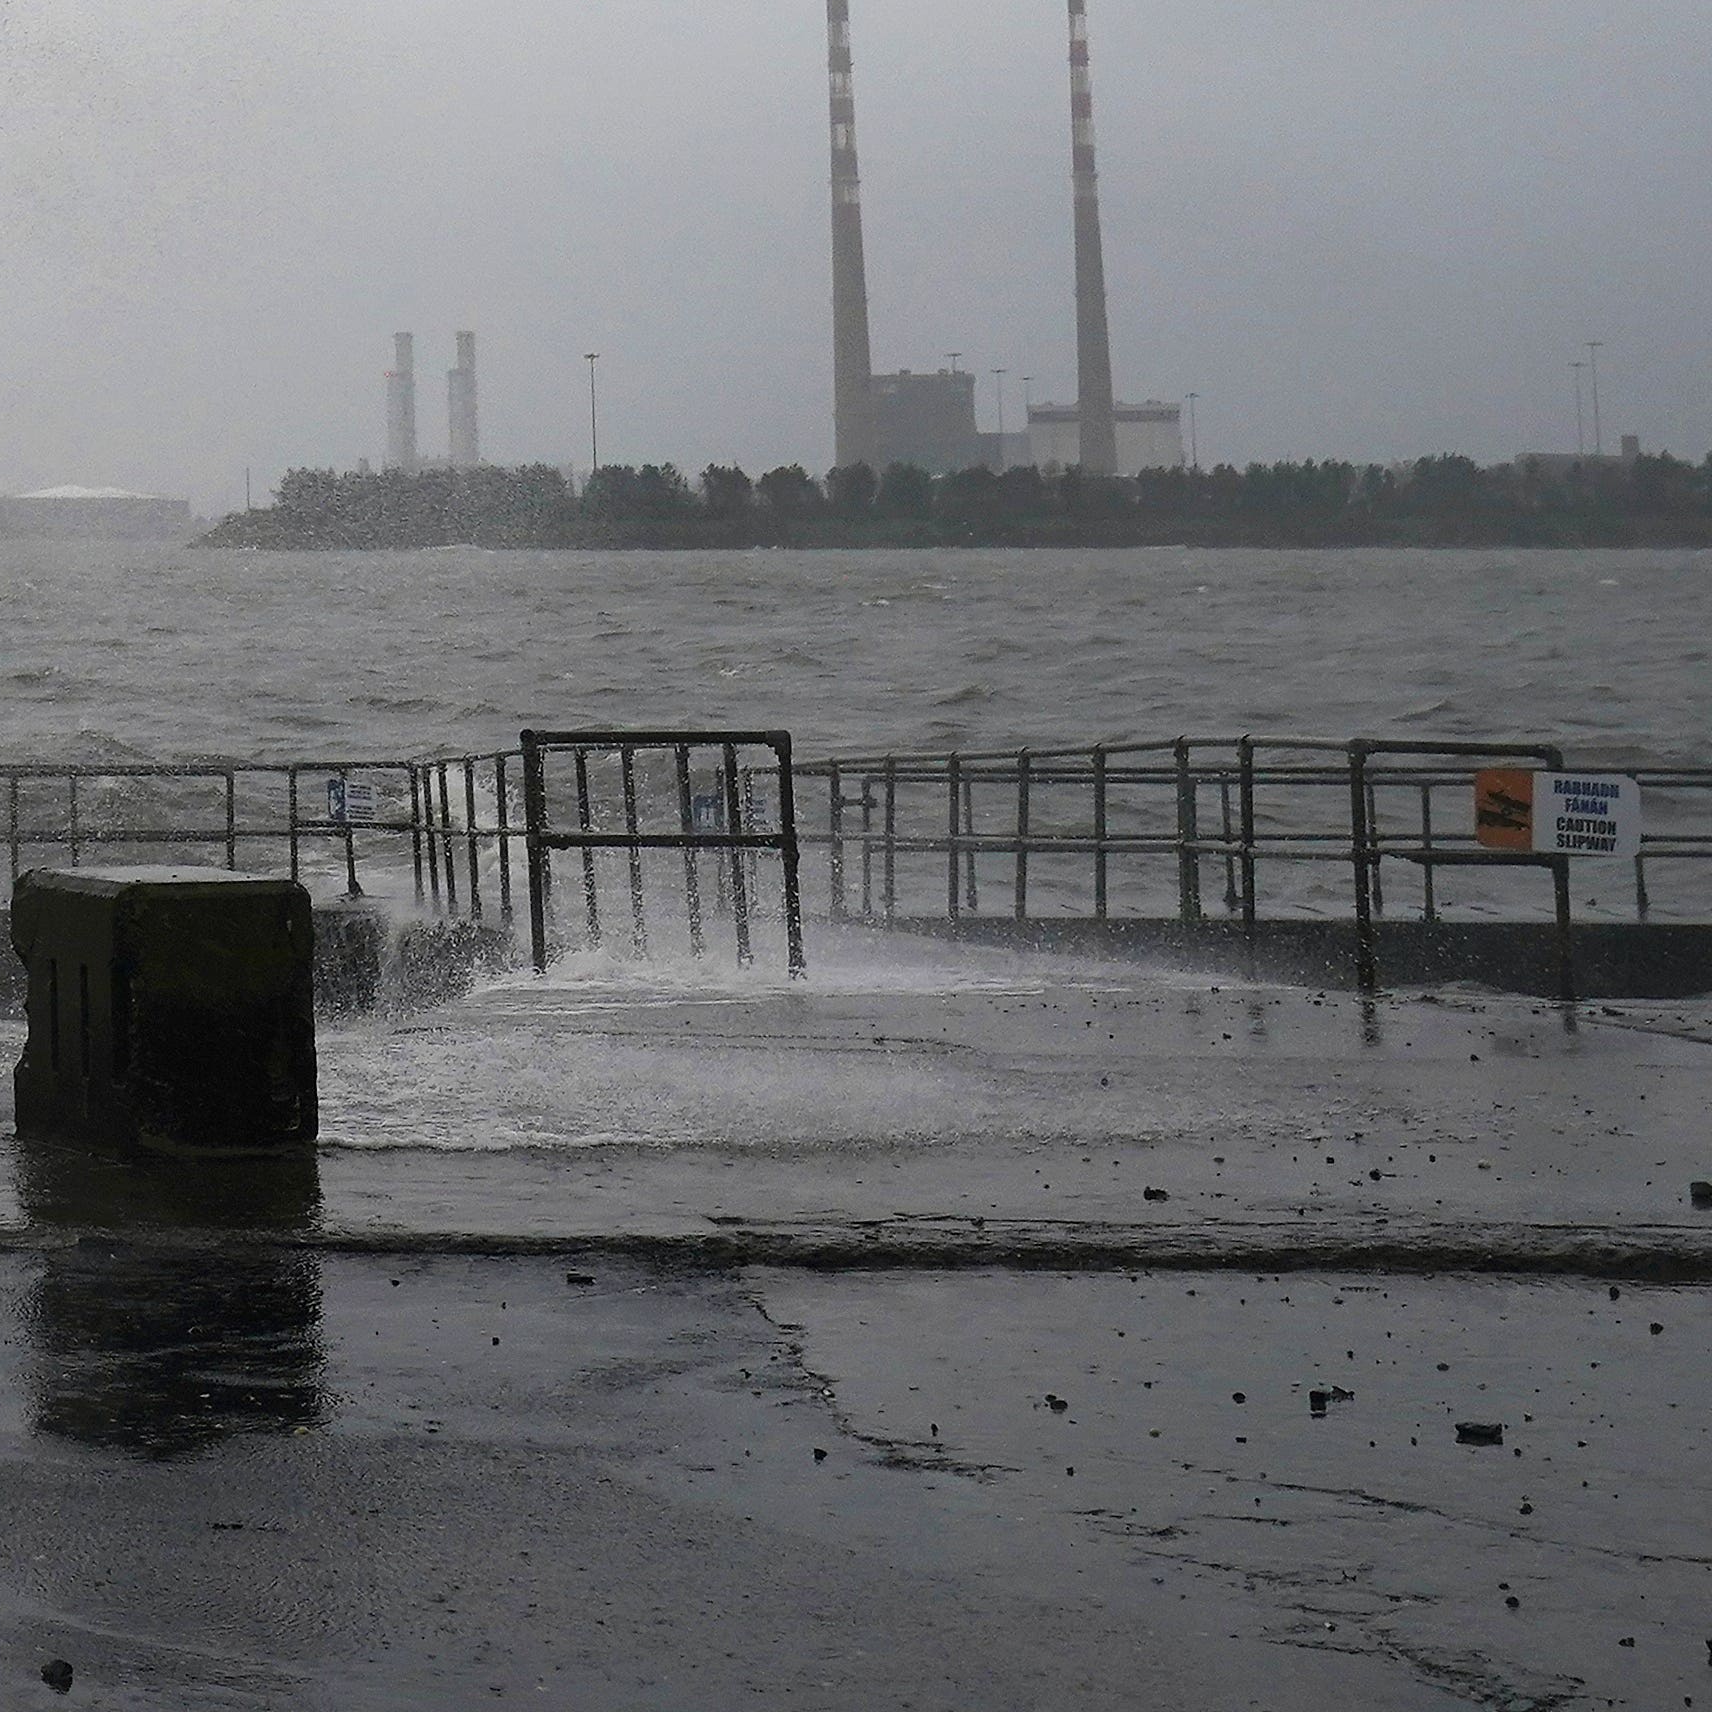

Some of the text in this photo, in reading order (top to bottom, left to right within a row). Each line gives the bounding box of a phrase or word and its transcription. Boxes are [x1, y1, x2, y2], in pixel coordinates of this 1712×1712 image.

[1554, 779, 1619, 798] RABHADH
[1556, 816, 1616, 835] CAUTION
[1556, 833, 1616, 851] SLIPWAY
